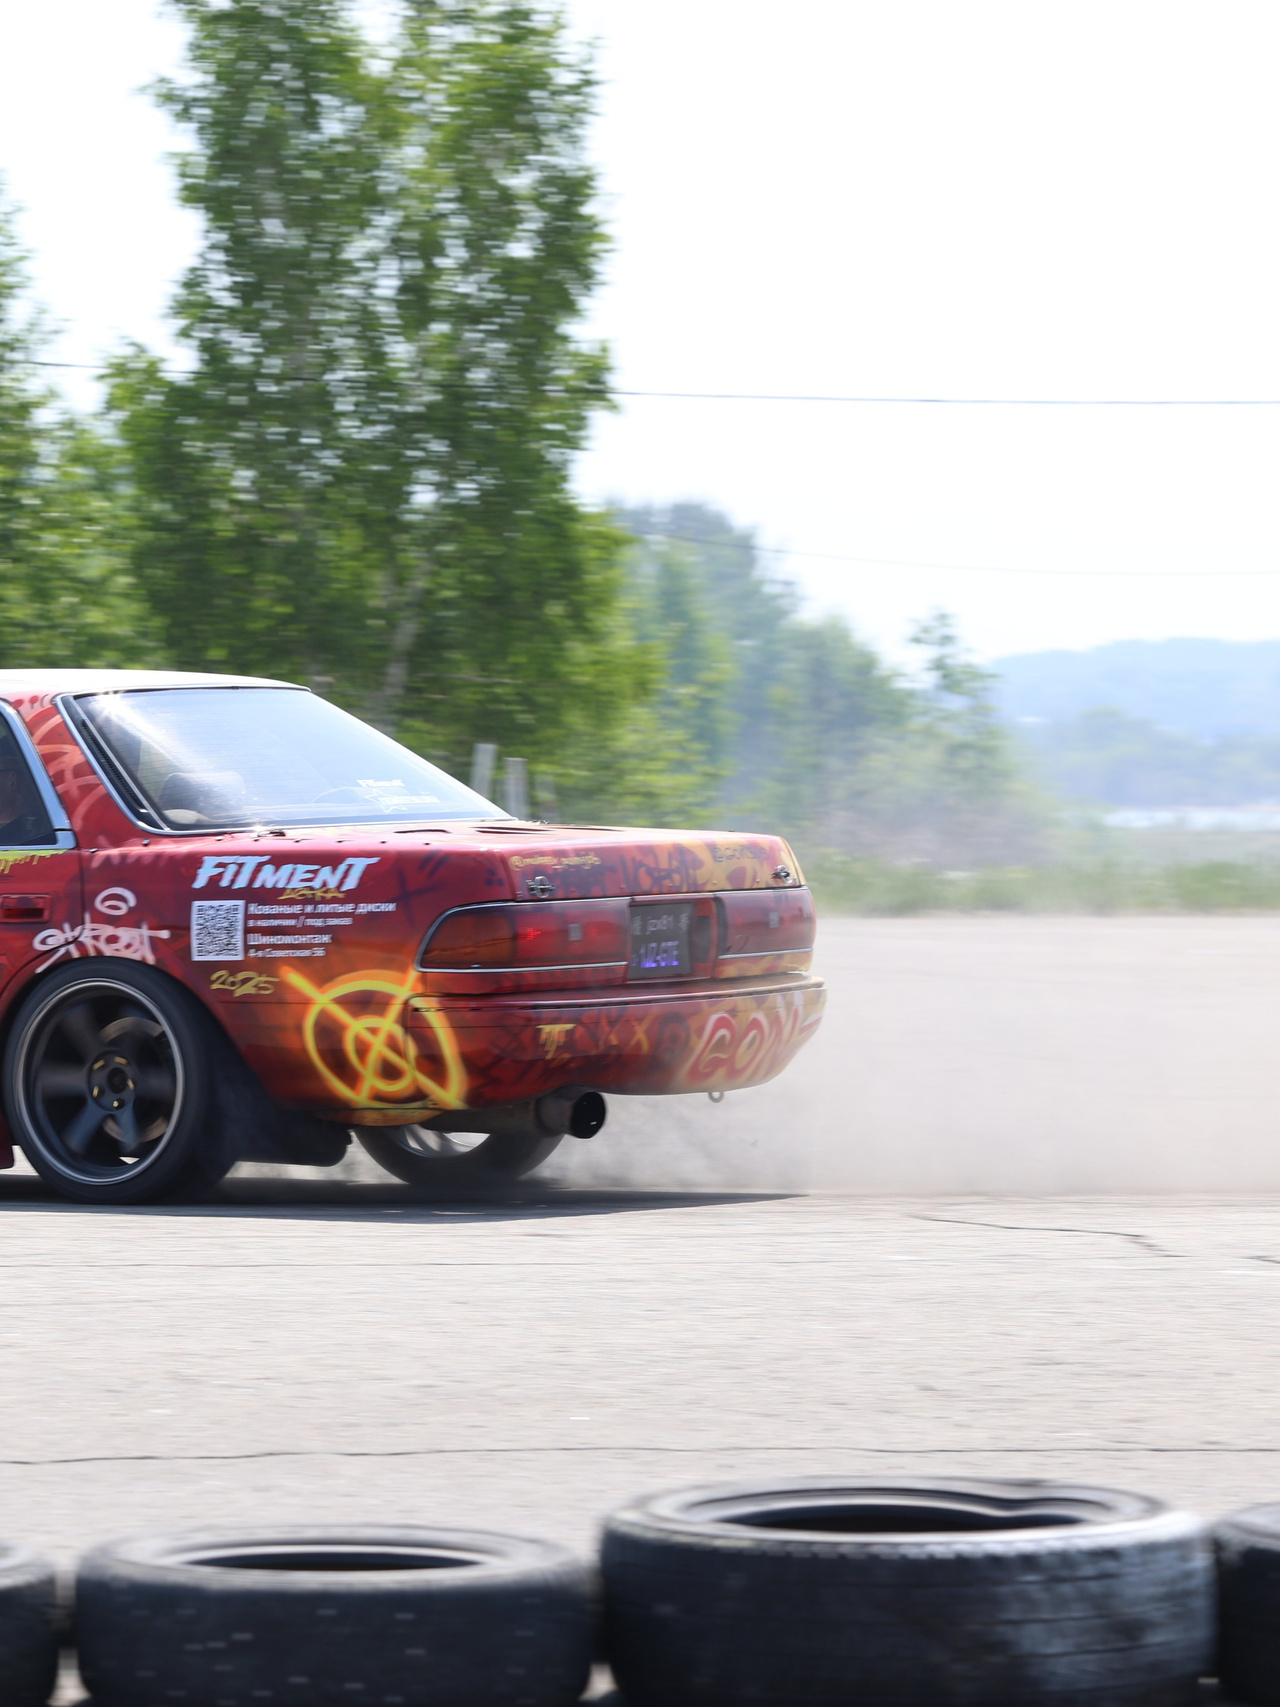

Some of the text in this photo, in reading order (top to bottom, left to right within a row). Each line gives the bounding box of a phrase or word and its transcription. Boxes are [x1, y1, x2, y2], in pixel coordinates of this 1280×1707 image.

[248, 903, 397, 914] Кованые и литые диски
[247, 933, 332, 945] Шиномонтаж
[210, 970, 280, 997] 2025
